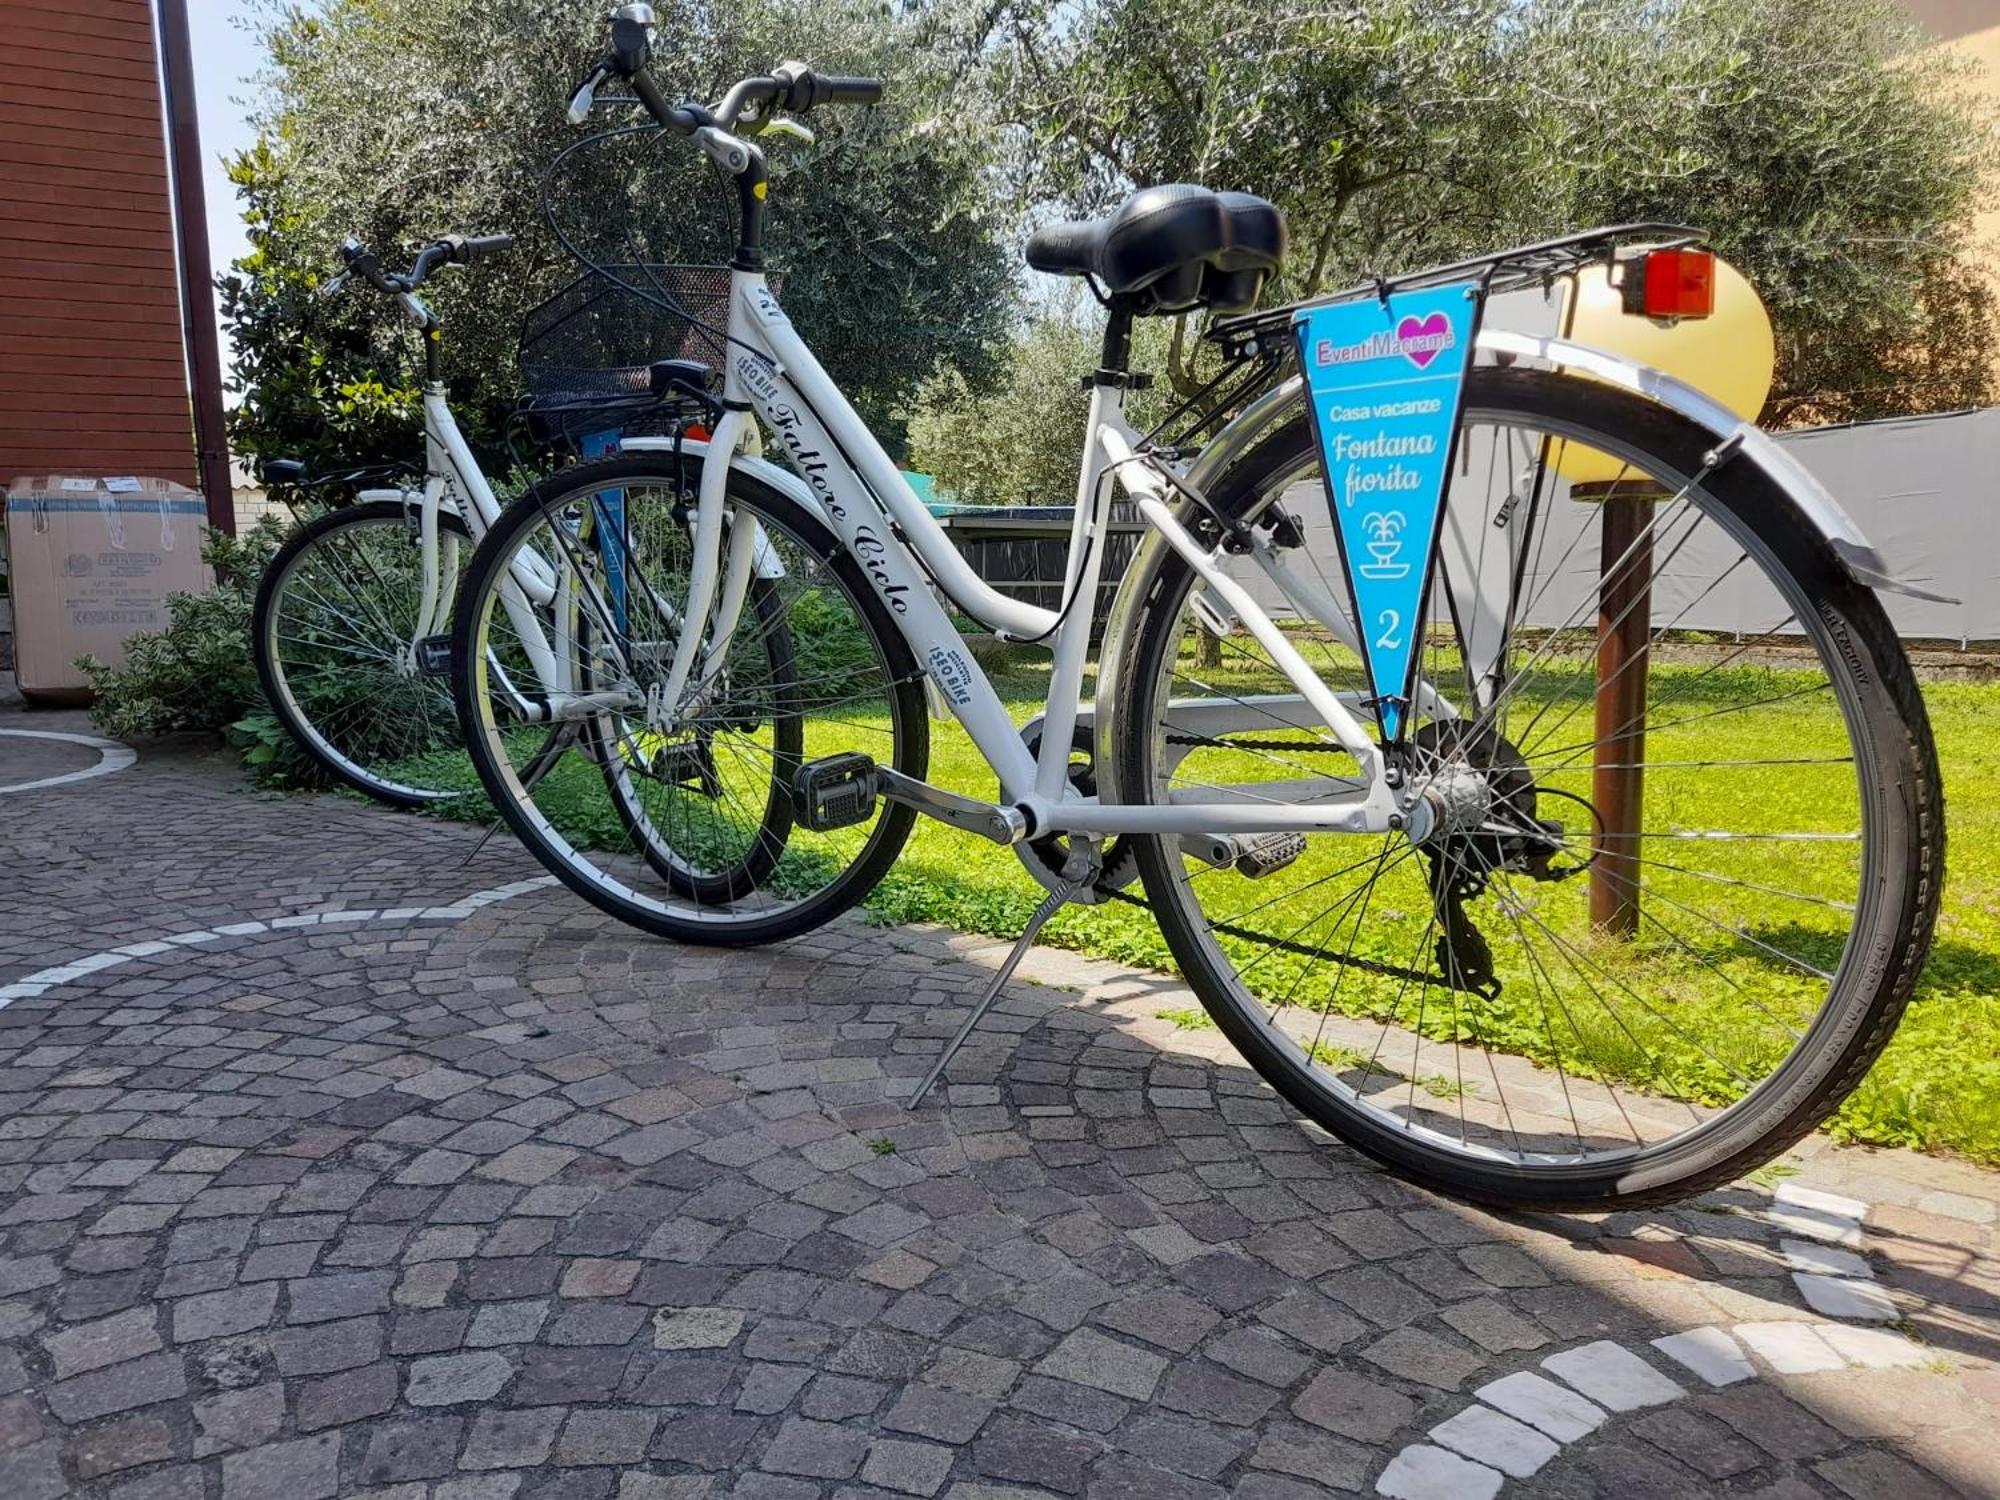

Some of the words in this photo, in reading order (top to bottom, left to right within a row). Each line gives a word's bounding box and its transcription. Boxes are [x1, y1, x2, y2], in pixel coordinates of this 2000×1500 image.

[736, 356, 758, 380] ISEO
[755, 376, 779, 400] BIKE
[1330, 405, 1370, 422] Casa
[1374, 398, 1440, 416] vacanze
[1332, 429, 1437, 462] Fontana
[1345, 463, 1422, 507] fiorita
[767, 403, 847, 522] Fattore
[854, 525, 910, 617] Ciclo
[1376, 609, 1401, 649] 2
[929, 646, 953, 676] ISEO
[947, 676, 971, 705] BIKE
